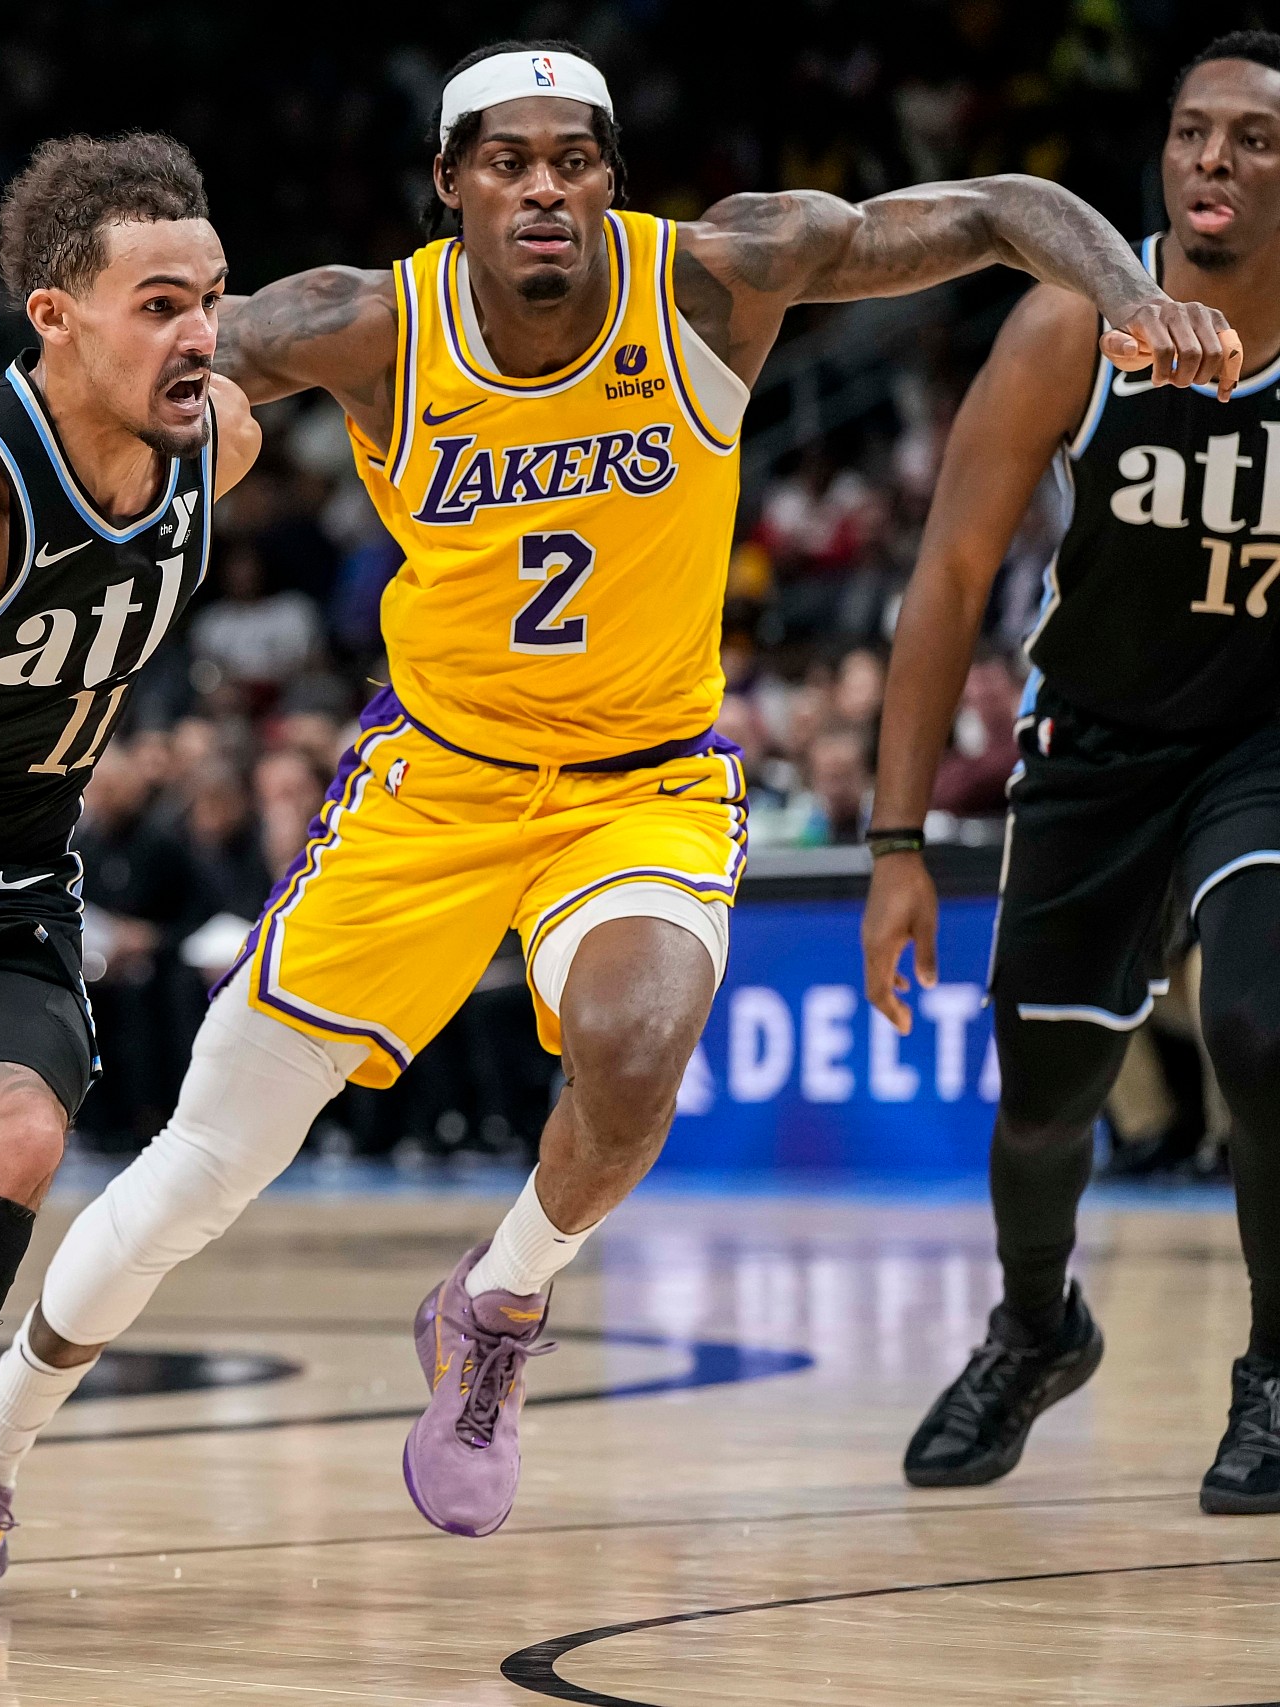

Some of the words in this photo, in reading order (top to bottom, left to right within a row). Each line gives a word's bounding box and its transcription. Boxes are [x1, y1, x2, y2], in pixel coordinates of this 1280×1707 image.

[605, 377, 666, 400] bibigo
[160, 523, 173, 536] the
[172, 490, 198, 549] Y
[410, 424, 679, 525] LAKERS
[1110, 420, 1280, 536] atl
[509, 530, 596, 655] 2
[1190, 536, 1280, 619] 17
[27, 683, 128, 776] 11
